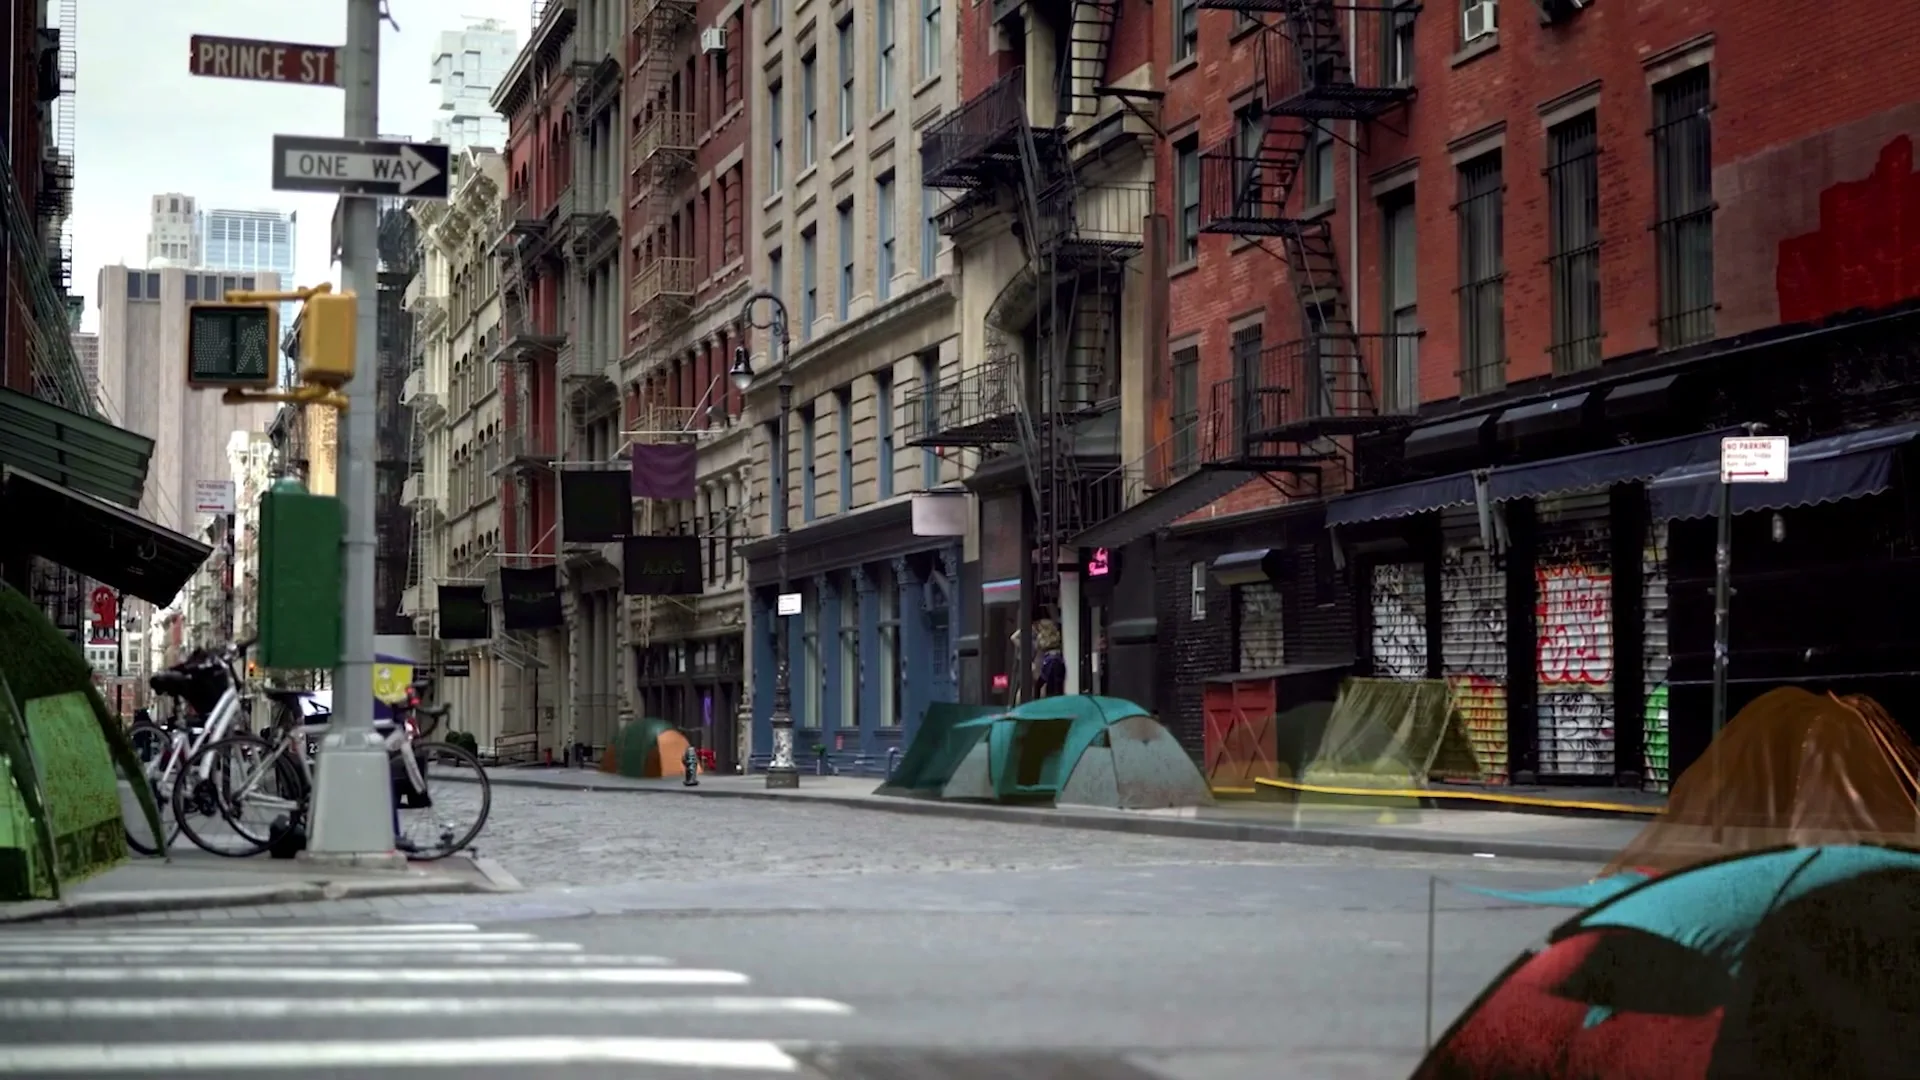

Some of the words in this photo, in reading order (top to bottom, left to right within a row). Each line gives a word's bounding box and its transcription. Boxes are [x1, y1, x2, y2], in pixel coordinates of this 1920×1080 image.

[200, 43, 287, 79] PRINCE
[300, 52, 328, 83] ST
[299, 154, 348, 177] ONE
[372, 158, 422, 180] WAY
[1740, 442, 1771, 450] PARKING
